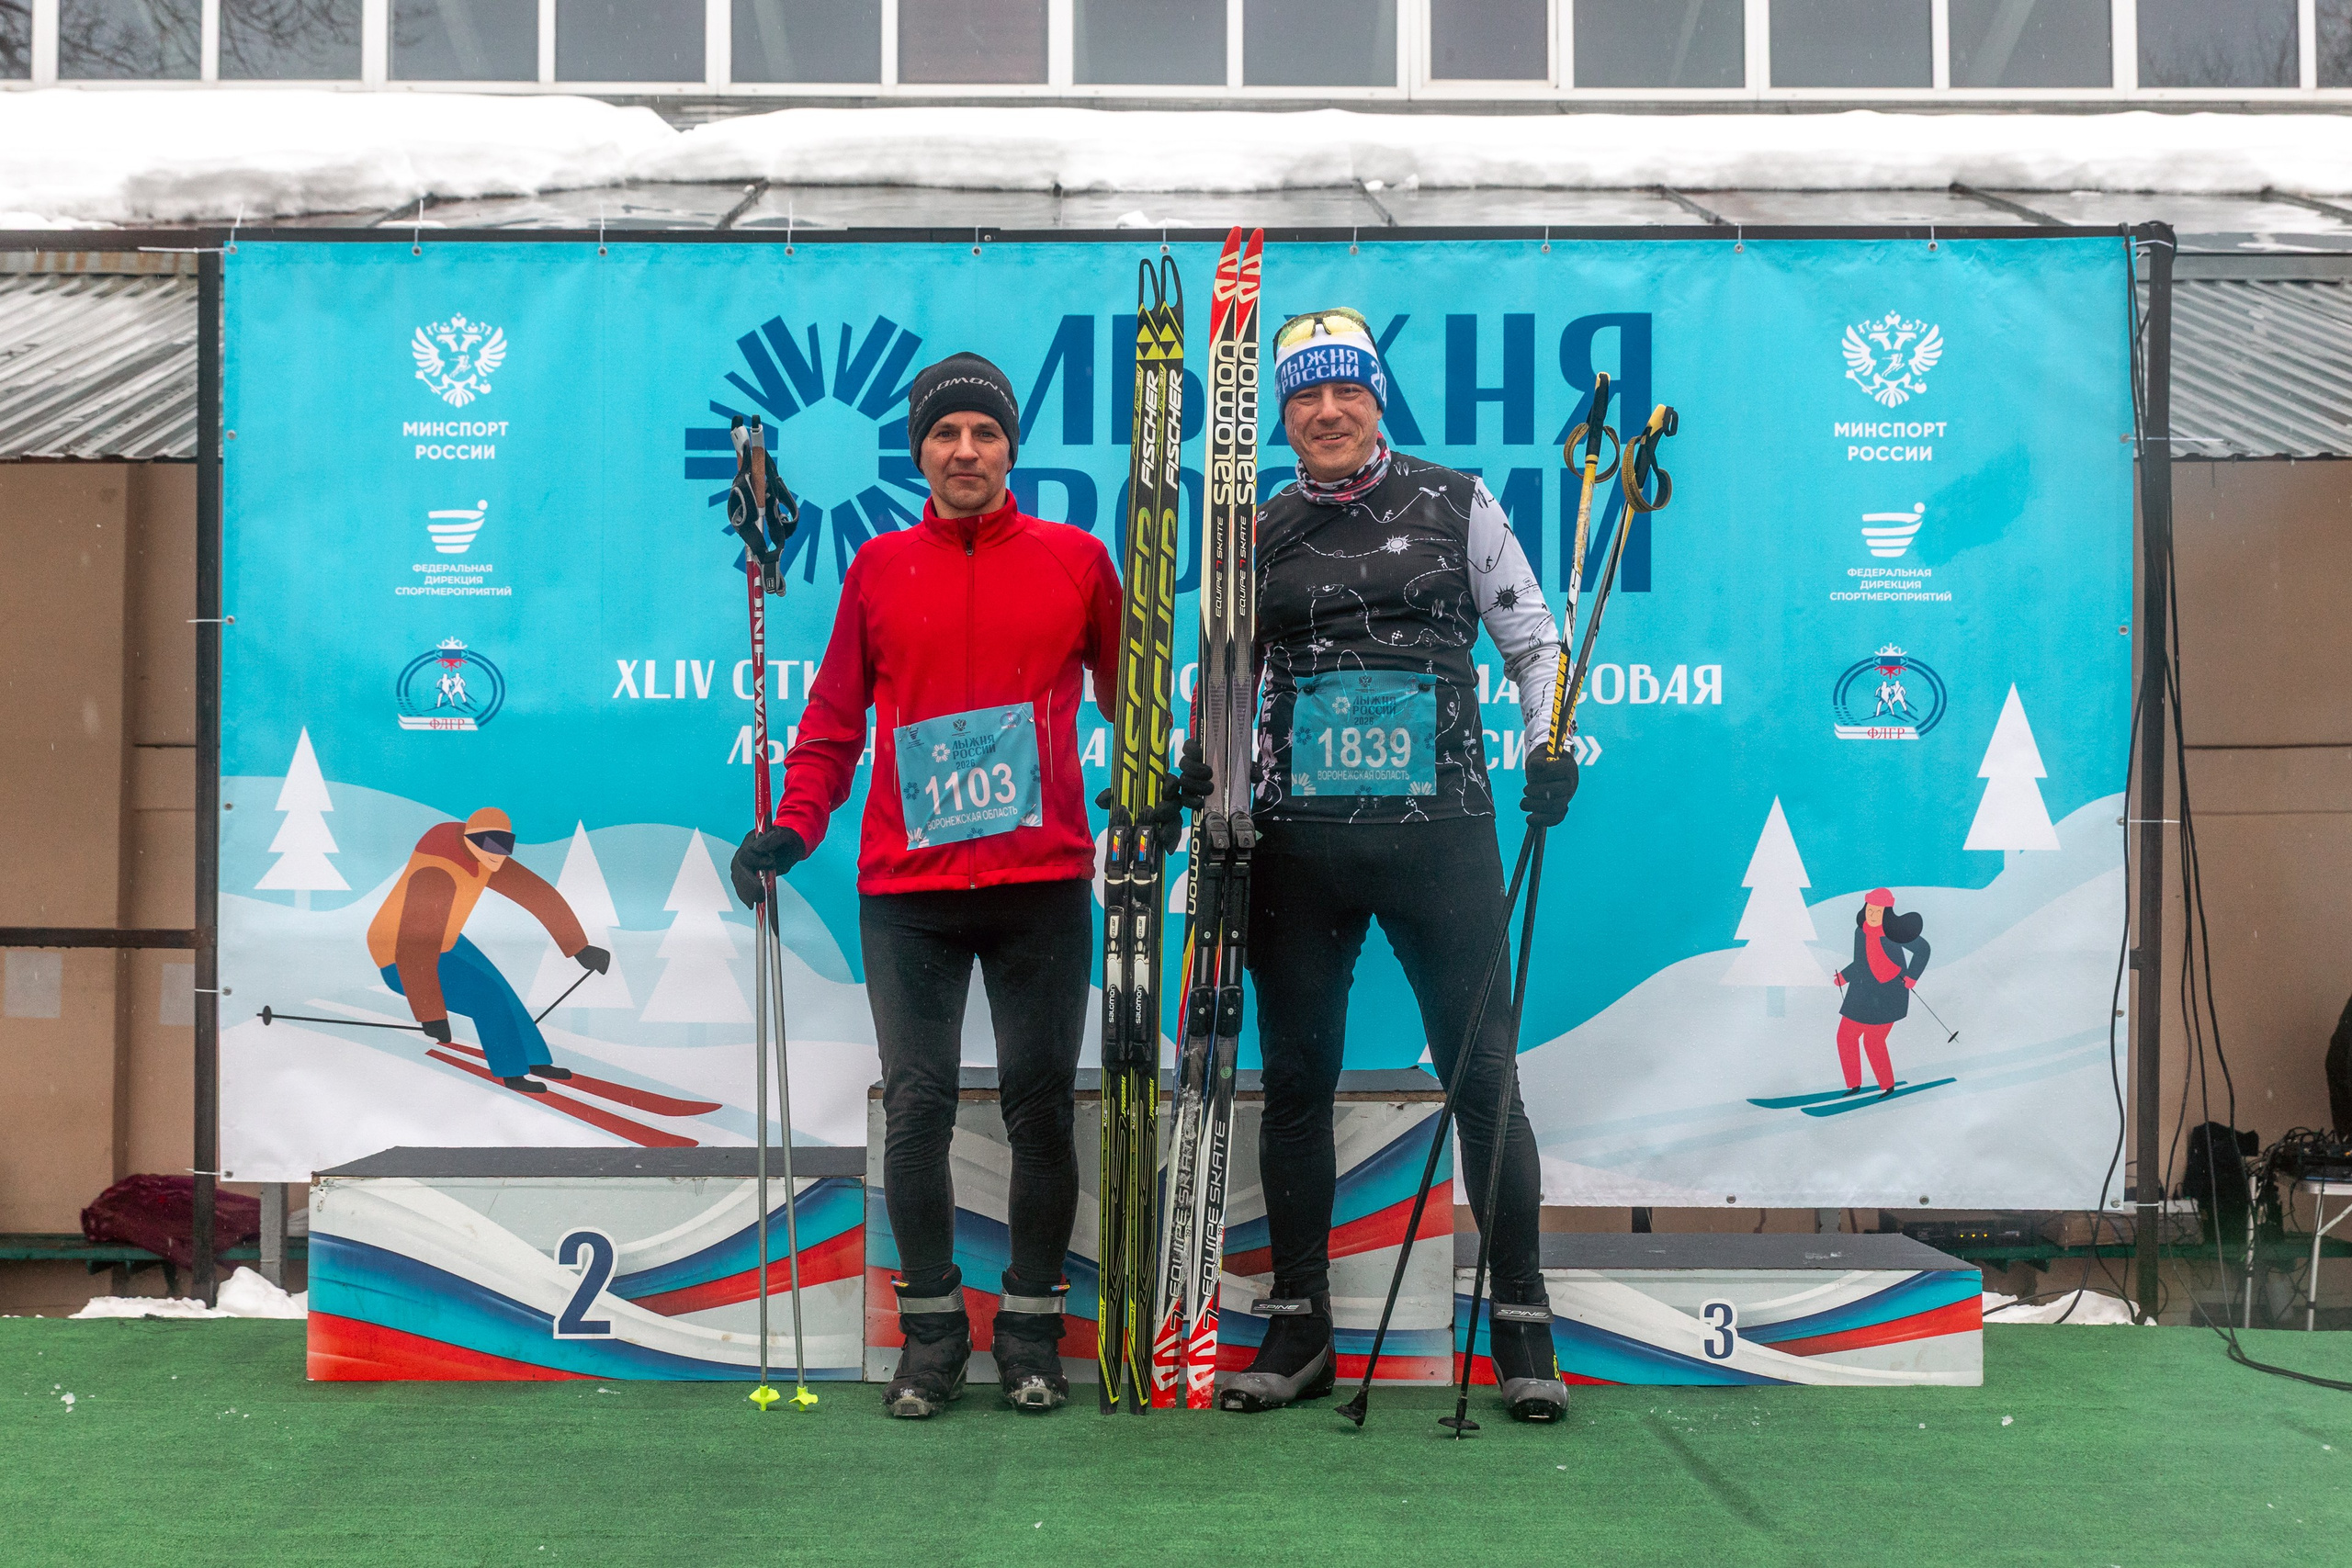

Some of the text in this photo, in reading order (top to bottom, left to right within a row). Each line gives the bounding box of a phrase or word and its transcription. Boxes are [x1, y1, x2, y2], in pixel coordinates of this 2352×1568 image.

[1280, 348, 1359, 379] ЛЫЖНЯ
[1281, 364, 1360, 395] РОССИИ
[402, 421, 509, 437] МИНСПОРТ
[1140, 369, 1159, 491] FISCHER
[1165, 368, 1183, 491] FISCHER
[1834, 422, 1947, 438] МИНСПОРТ
[414, 445, 496, 460] РОССИИ
[1848, 446, 1933, 461] РОССИИ
[412, 563, 493, 574] ФЕДЕРАЛЬНАЯ
[1847, 568, 1932, 579] ФЕДЕРАЛЬНАЯ
[424, 575, 483, 586] ДИРЕКЦИЯ
[1860, 580, 1922, 590] ДИРЕКЦИЯ
[394, 585, 513, 596] СПОРТМЕРОПРИЯТИЙ
[1829, 590, 1952, 602] СПОРТМЕРОПРИЯТИЙ
[612, 660, 716, 700] XLIV
[1472, 663, 1723, 705] АОВАЯ
[1352, 695, 1396, 705] ЛЫЖНЯ
[1546, 651, 1567, 756] MARPETTI
[754, 673, 766, 764] WAY
[1352, 705, 1396, 716] РОССИИ
[429, 716, 466, 731] ФЛГР
[1867, 726, 1905, 739] ФЛГР
[952, 735, 996, 750] ЛЫЖНЯ
[1317, 727, 1411, 768] 1839
[953, 744, 997, 761] РОССИИ
[956, 761, 976, 771] 2026
[1317, 770, 1410, 781] ВОРОНЕЖСКАЯ ОБЛАСТЬ
[925, 763, 1017, 816] 1103
[927, 806, 1018, 830] ВОРОНЕЖСКАЯ ОБЛАСТЬ
[1188, 808, 1203, 915] alomon
[1209, 1119, 1226, 1204] SKATE
[1169, 1208, 1187, 1297] EQUIPE
[1202, 1207, 1220, 1297] EQUIPE
[558, 1231, 614, 1335] 2
[1257, 1303, 1300, 1313] SPINE
[1499, 1308, 1549, 1319] SPINE
[1703, 1303, 1734, 1359] 3
